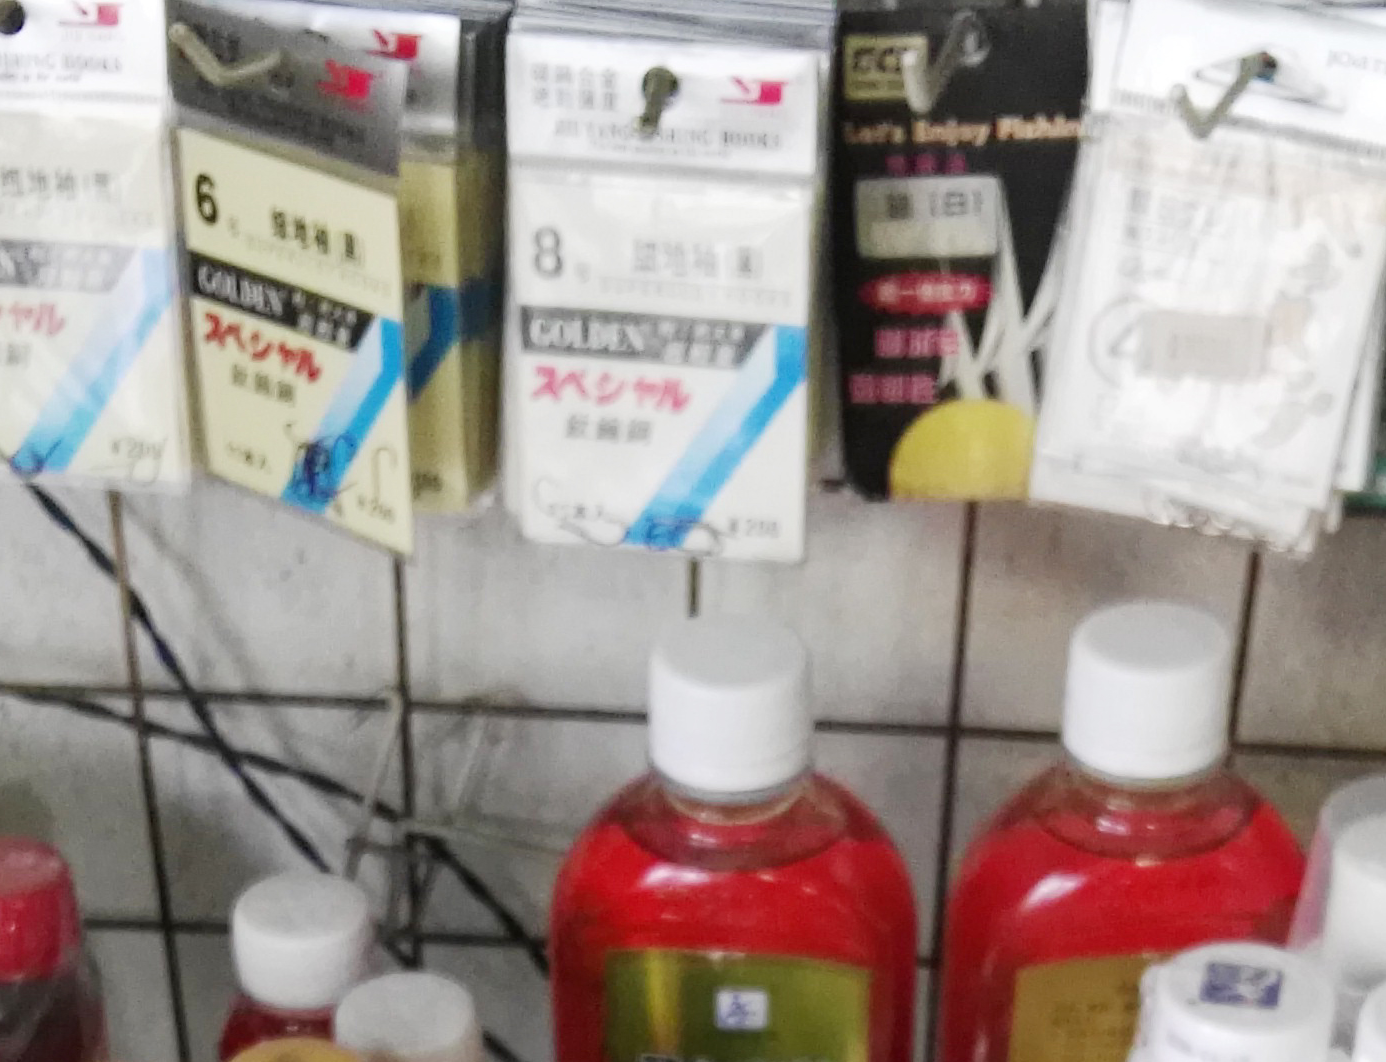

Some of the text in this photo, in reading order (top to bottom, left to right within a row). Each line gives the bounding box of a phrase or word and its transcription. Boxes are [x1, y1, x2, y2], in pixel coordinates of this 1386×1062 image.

[196, 173, 219, 225] 6
[533, 228, 564, 278] 8
[197, 265, 285, 315] GOLDEN
[204, 311, 323, 383] スペシャル
[528, 317, 647, 351] GOLDEN
[530, 365, 691, 415] スペシャル
